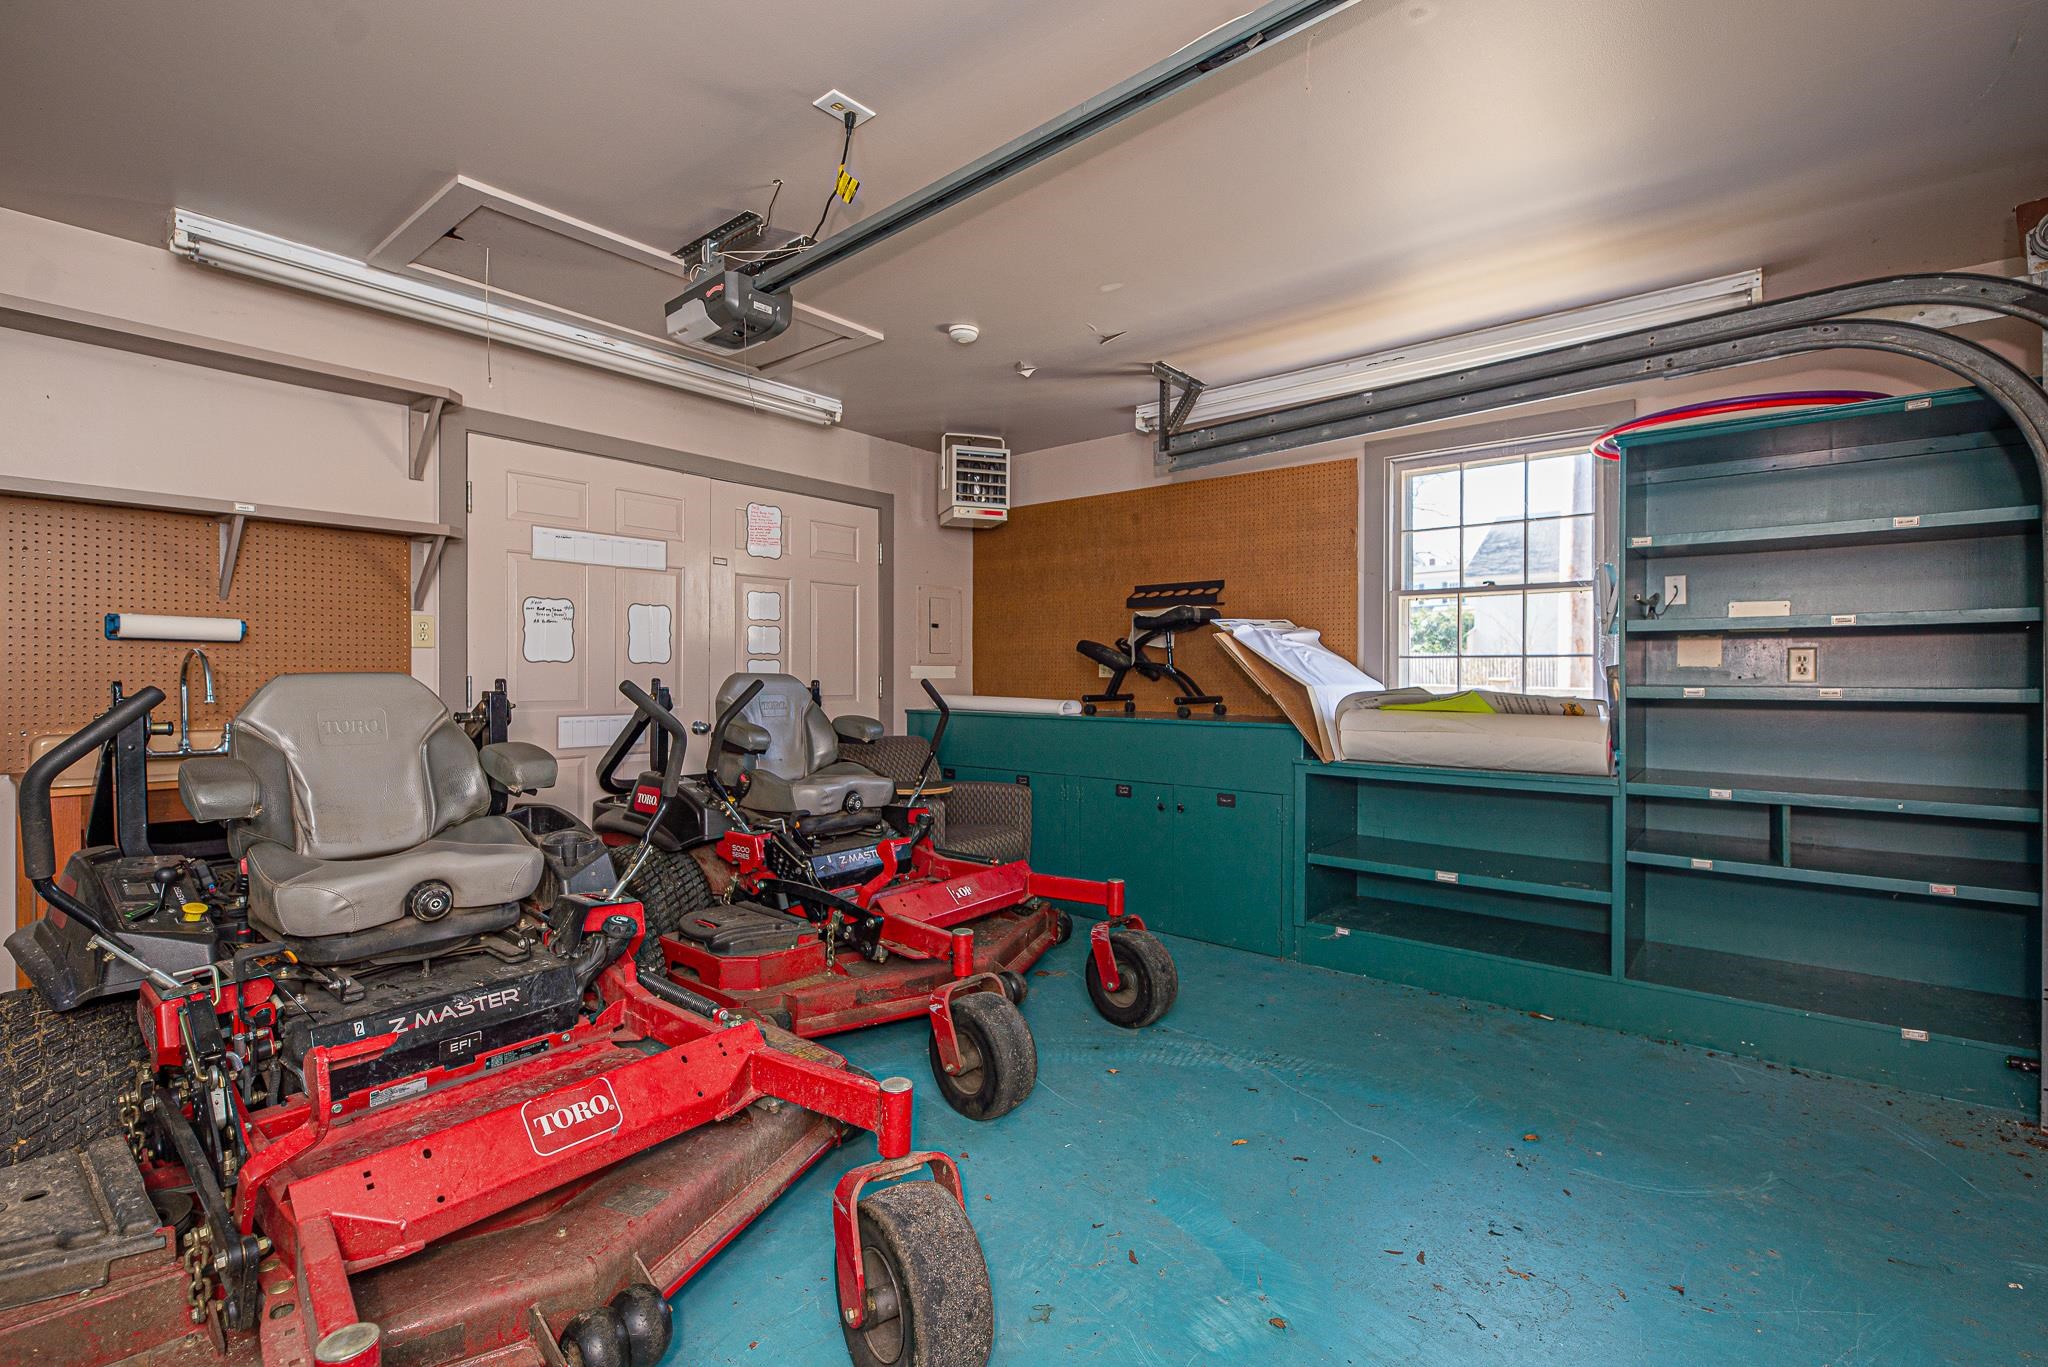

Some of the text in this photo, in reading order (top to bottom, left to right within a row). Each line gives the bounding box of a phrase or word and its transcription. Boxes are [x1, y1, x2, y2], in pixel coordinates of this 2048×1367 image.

[637, 793, 656, 806] TORO
[732, 844, 750, 854] 5000
[732, 851, 750, 861] SERIES
[839, 855, 848, 865] Z
[388, 988, 520, 1033] Z MASTER
[450, 1038, 471, 1053] EFI
[533, 1095, 609, 1136] TORO
